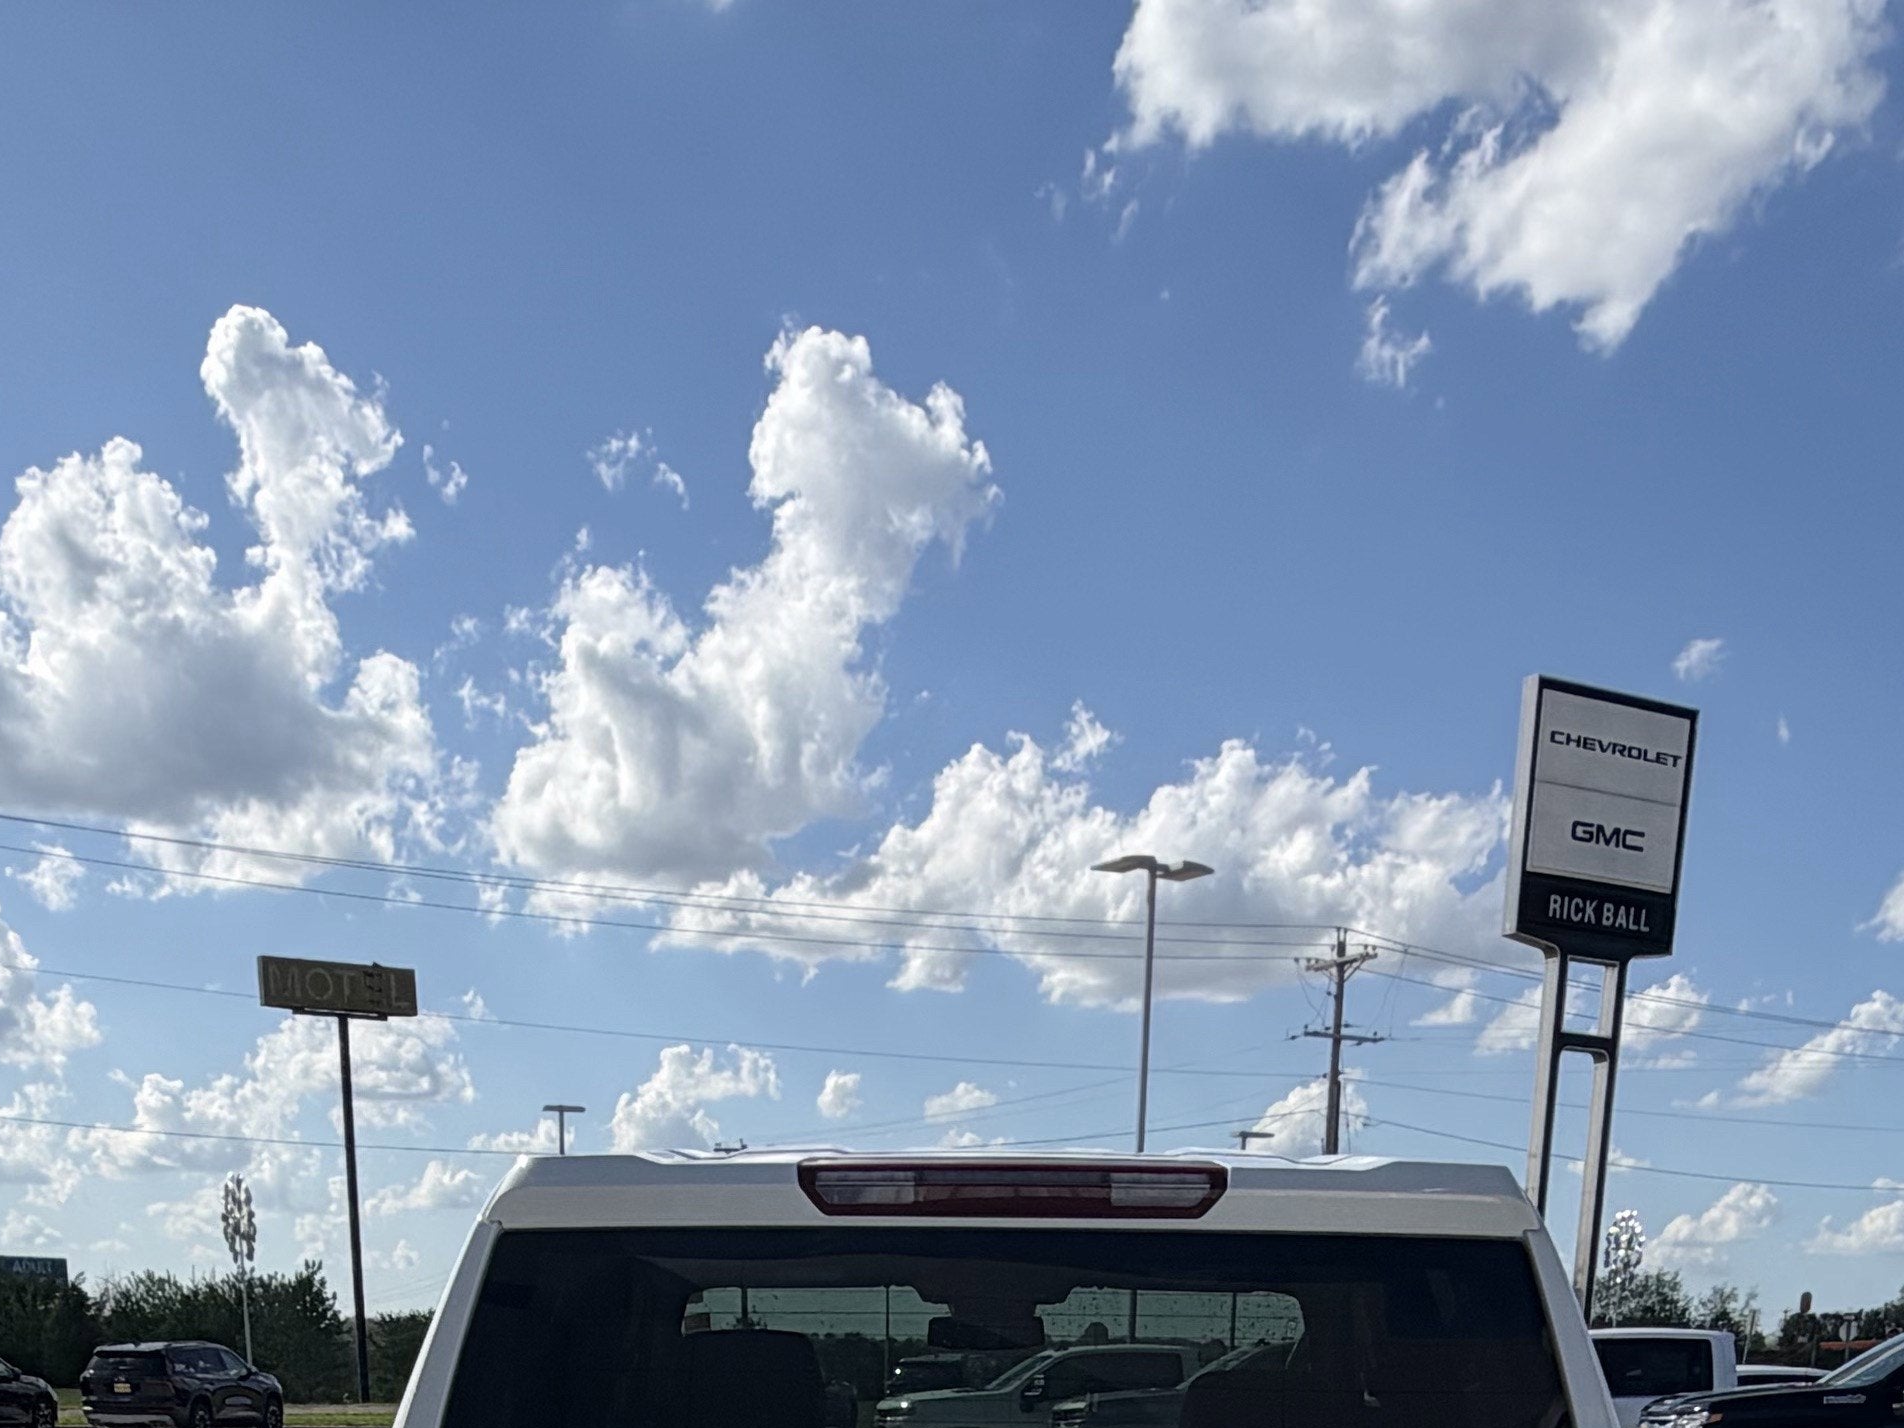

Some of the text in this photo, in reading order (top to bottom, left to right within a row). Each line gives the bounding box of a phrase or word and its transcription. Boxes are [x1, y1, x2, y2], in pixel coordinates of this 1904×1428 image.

[1550, 730, 1682, 768] CHEVROLET
[1571, 820, 1645, 852] GMC
[1549, 894, 1650, 932] RICK BALL
